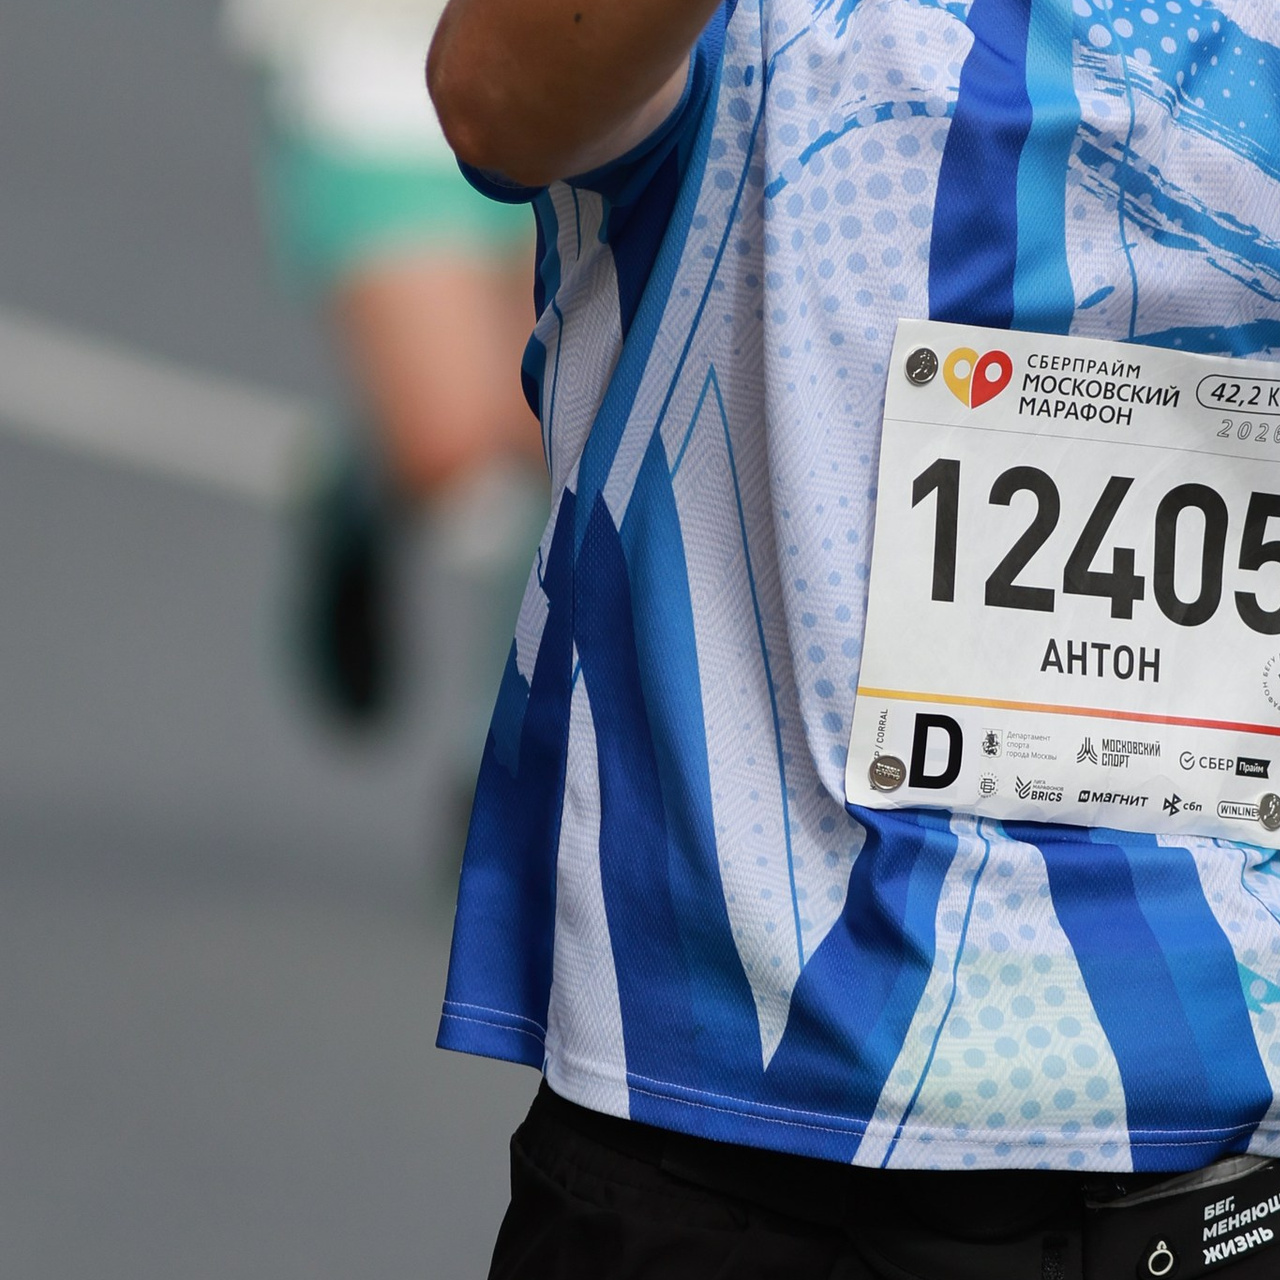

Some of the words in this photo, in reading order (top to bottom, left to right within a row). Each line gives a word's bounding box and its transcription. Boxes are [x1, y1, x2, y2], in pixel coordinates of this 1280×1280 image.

[1027, 353, 1141, 379] СБЕРПРАЙМ
[1022, 373, 1180, 408] МОСКОВСКИЙ
[1210, 382, 1261, 407] 42,2
[1018, 396, 1133, 426] МАРАФОН
[1040, 638, 1161, 683] АНТОН
[876, 708, 888, 744] CORRAL
[1006, 730, 1051, 741] Департамент
[908, 712, 964, 790] D
[1006, 741, 1030, 750] спорта
[1102, 738, 1161, 757] МОСКОВСКИЙ
[1101, 752, 1130, 769] СПОРТ
[1199, 756, 1235, 771] СБЕР
[1239, 761, 1264, 774] Прайм
[1031, 790, 1063, 802] BRICS
[1220, 804, 1259, 818] WINLINE
[1204, 1195, 1235, 1221] БЕГ,
[1202, 1226, 1274, 1265] ЖИЗНЬ
